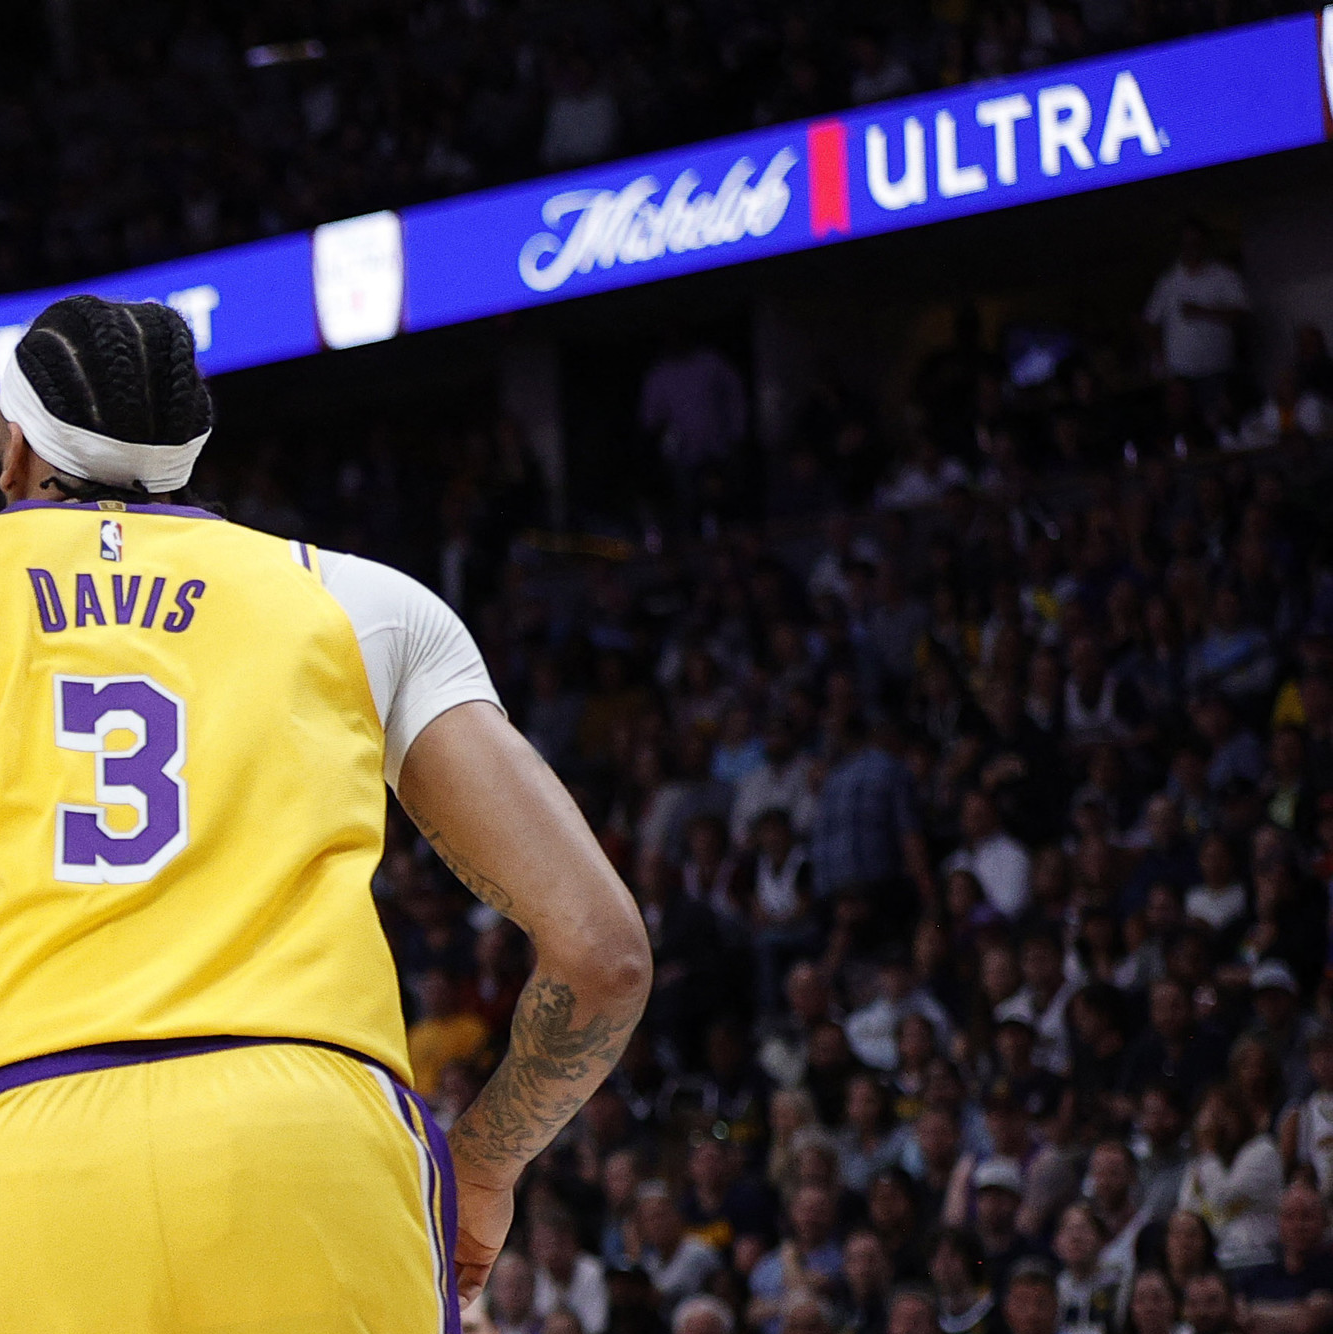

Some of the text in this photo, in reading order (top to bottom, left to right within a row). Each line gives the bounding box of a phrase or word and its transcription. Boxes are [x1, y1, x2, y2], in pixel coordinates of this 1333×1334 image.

[865, 70, 1164, 211] ULTRA
[26, 567, 206, 634] DAVIS
[53, 674, 190, 885] 3
